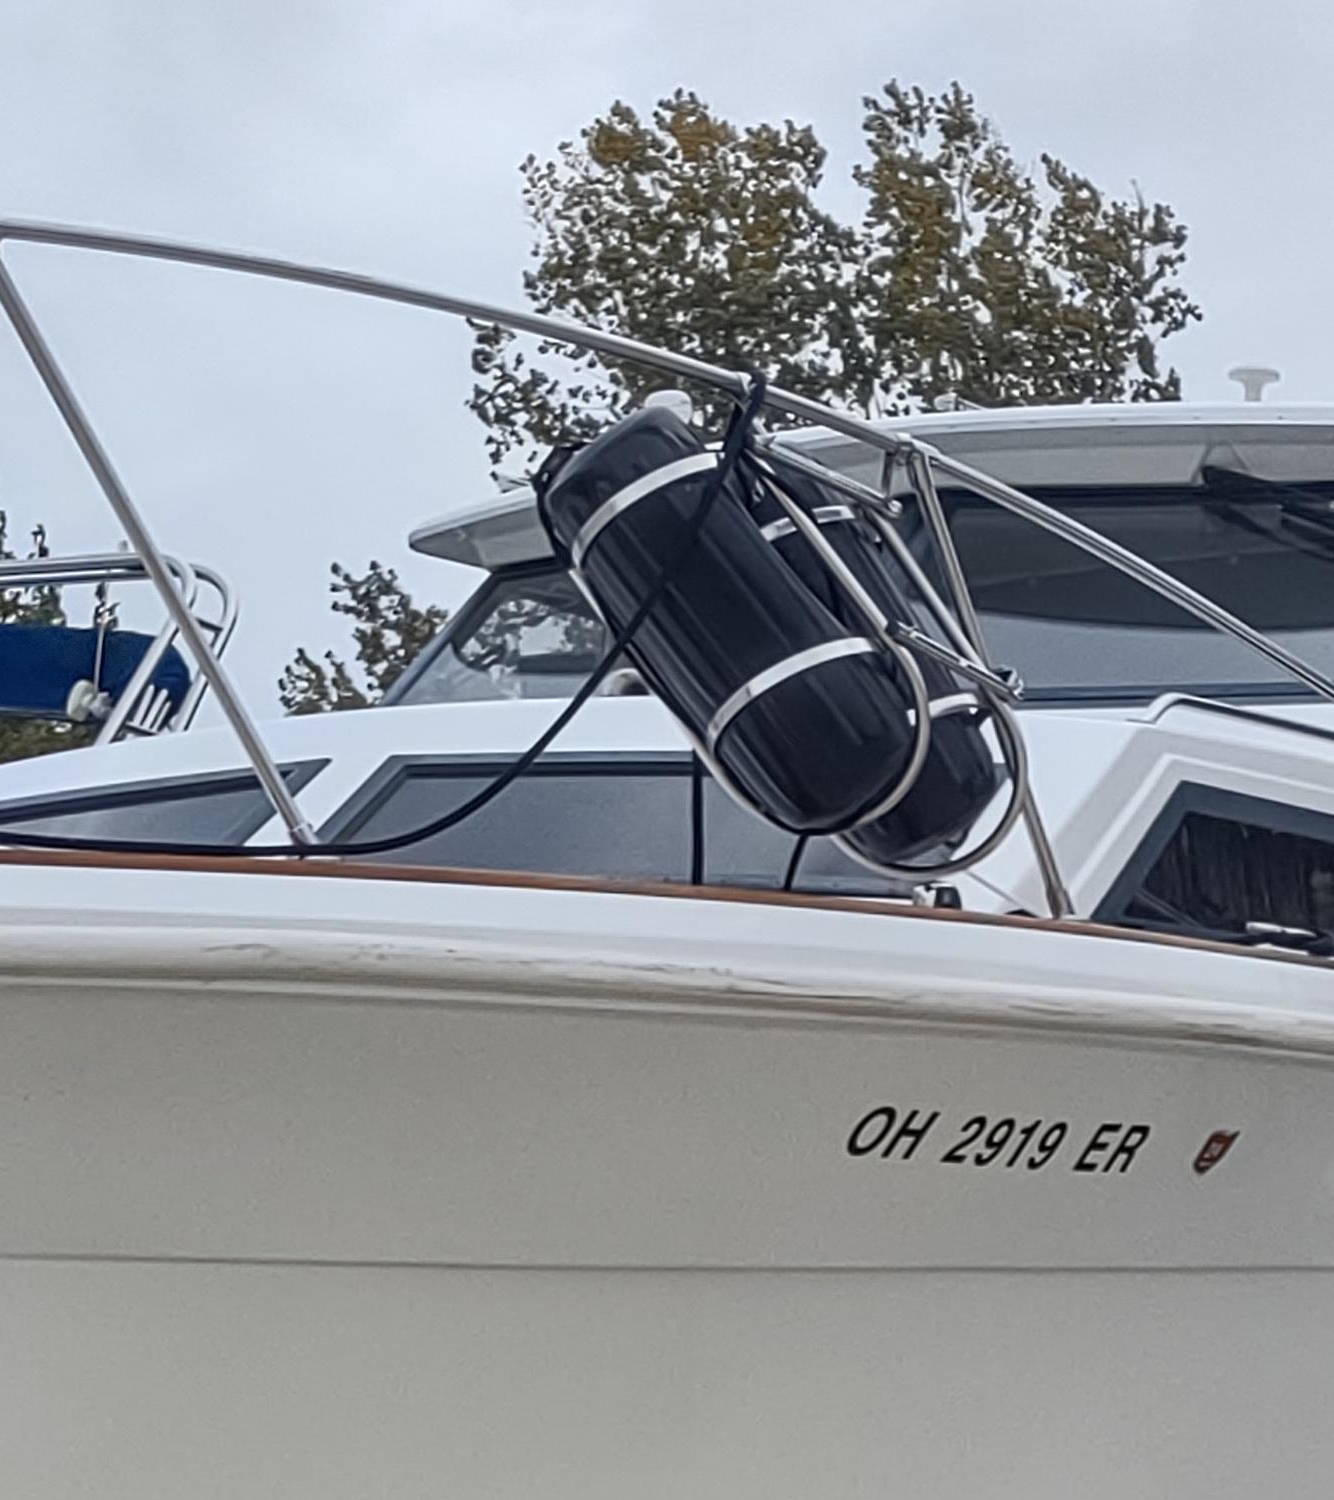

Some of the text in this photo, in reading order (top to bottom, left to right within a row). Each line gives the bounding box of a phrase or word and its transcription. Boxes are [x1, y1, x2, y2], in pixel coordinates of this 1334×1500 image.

[847, 1106, 941, 1160] OH
[939, 1115, 1068, 1171] 2919
[1072, 1122, 1151, 1174] ER
